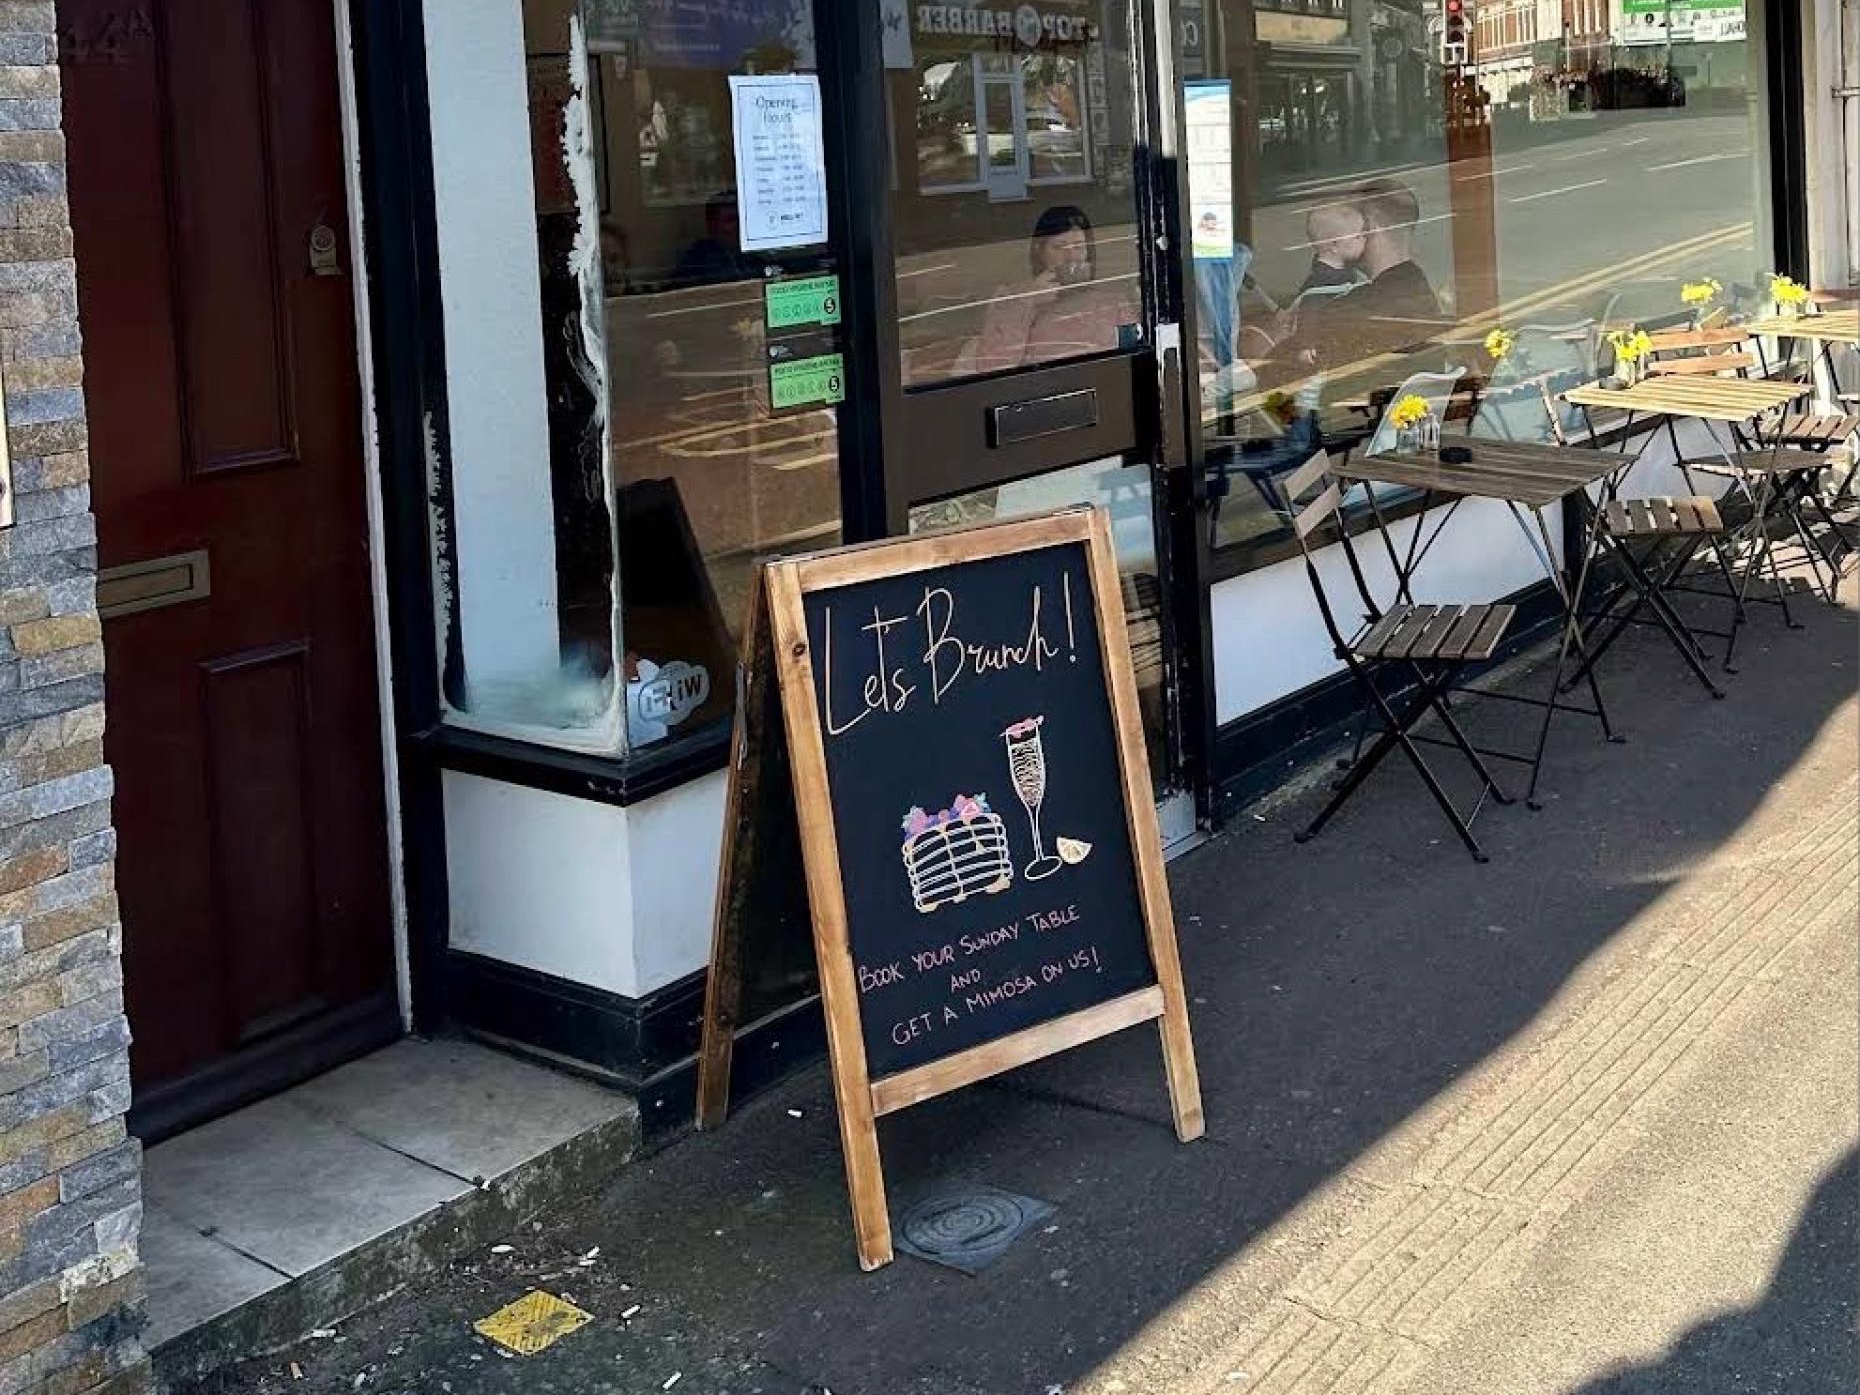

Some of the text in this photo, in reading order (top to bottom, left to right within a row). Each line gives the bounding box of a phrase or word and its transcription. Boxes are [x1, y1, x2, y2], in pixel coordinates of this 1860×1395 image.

[858, 904, 1080, 993] BOOK YOUR SUNDAY TABLE
[951, 968, 981, 993] AND
[892, 945, 1102, 1045] GET A MIMOSA ON US!
